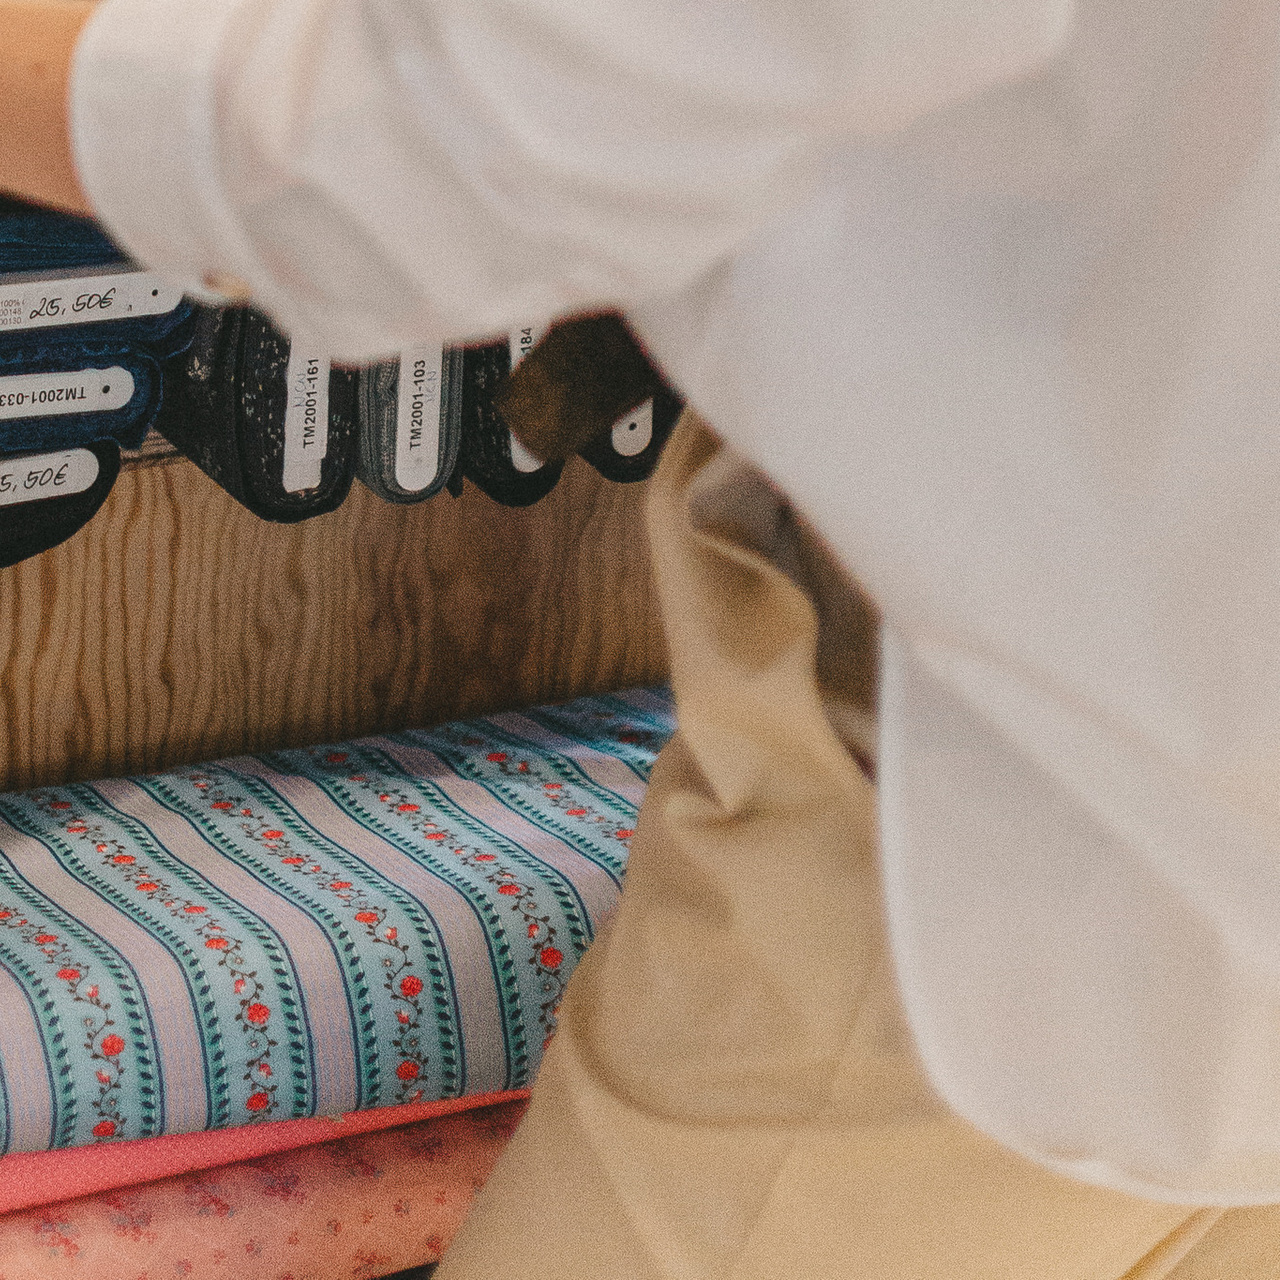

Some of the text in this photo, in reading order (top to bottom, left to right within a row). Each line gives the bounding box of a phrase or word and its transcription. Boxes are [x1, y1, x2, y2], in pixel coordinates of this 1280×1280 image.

[27, 287, 117, 319] 25,50€
[303, 358, 320, 449] TM2001-161
[409, 359, 426, 451] TM2001-103
